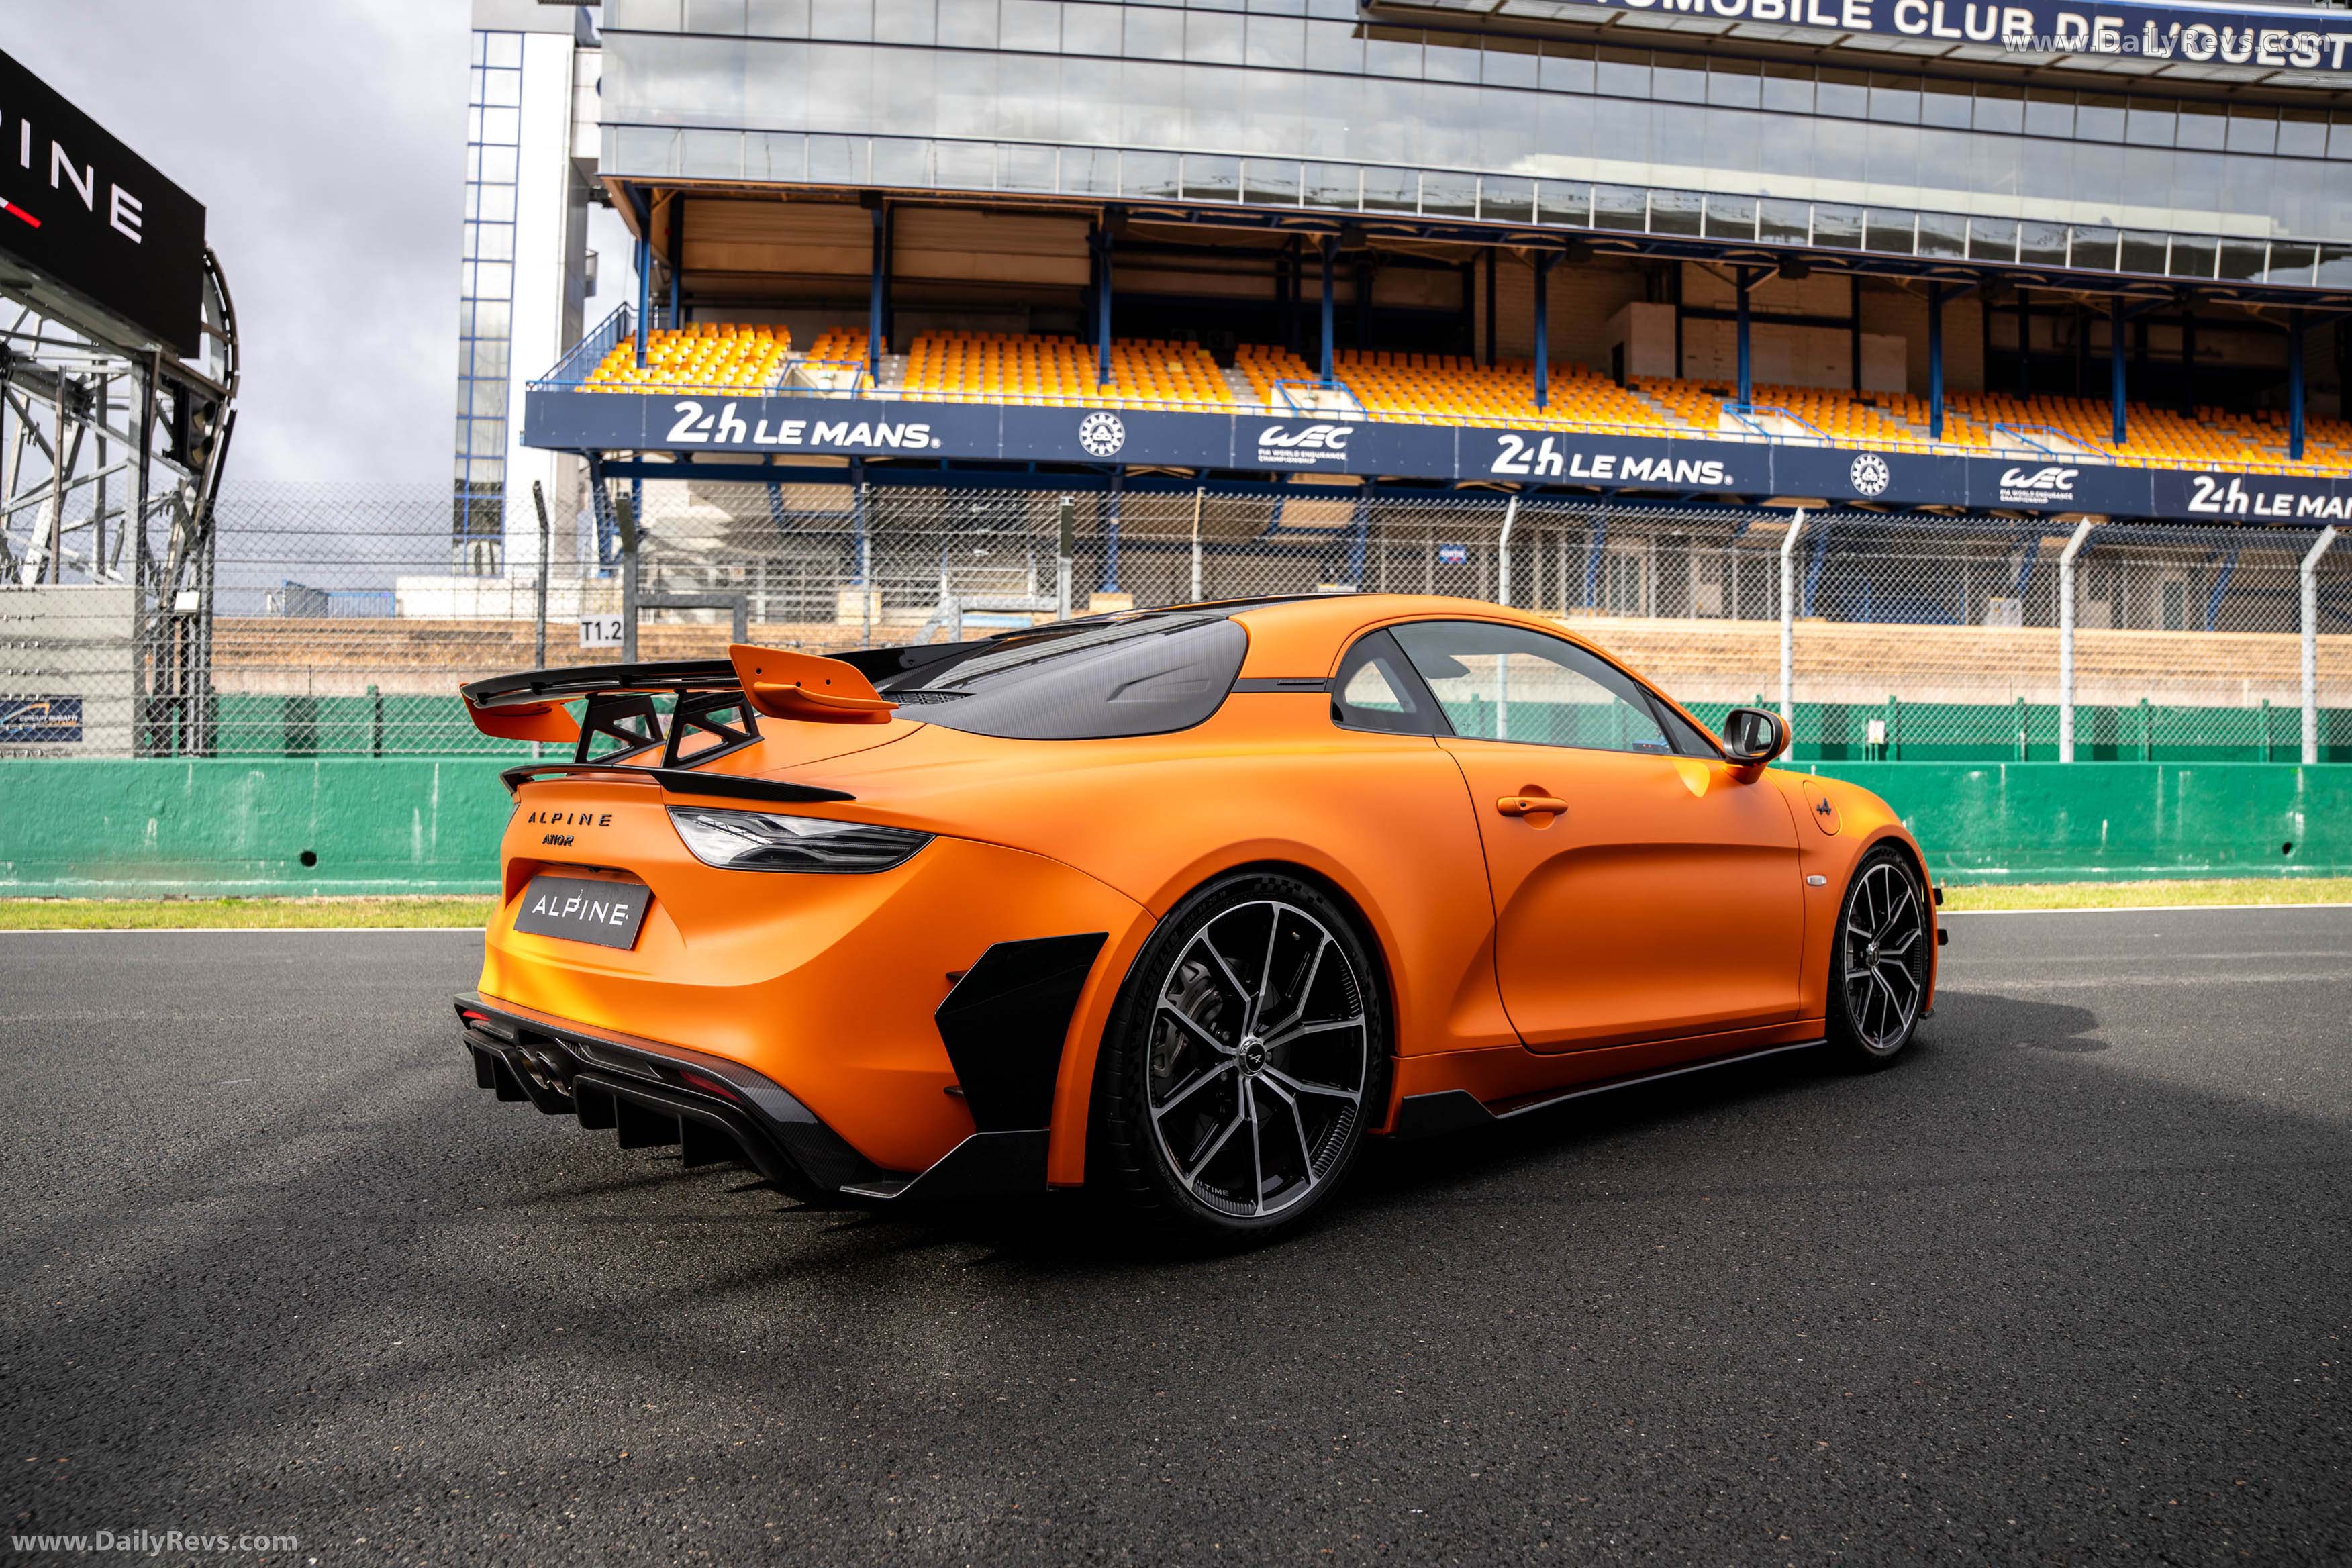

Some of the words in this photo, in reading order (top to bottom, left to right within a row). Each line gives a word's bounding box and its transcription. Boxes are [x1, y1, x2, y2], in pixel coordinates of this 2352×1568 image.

[1893, 0, 2035, 46] CLUB
[2056, 12, 2124, 54] DE
[0, 109, 143, 244] INE
[666, 401, 747, 444] 24h
[752, 419, 807, 445] LE
[1258, 425, 1355, 450] WEC
[1491, 434, 1564, 477] 24h
[1569, 454, 1617, 479] LE
[2000, 467, 2079, 491] WEC
[2188, 475, 2249, 514] 24h
[2253, 493, 2294, 516] LE
[581, 620, 622, 641] T1.2
[528, 812, 613, 827] ALPINE
[542, 833, 574, 847] A110R
[532, 894, 628, 926] ALPINE
